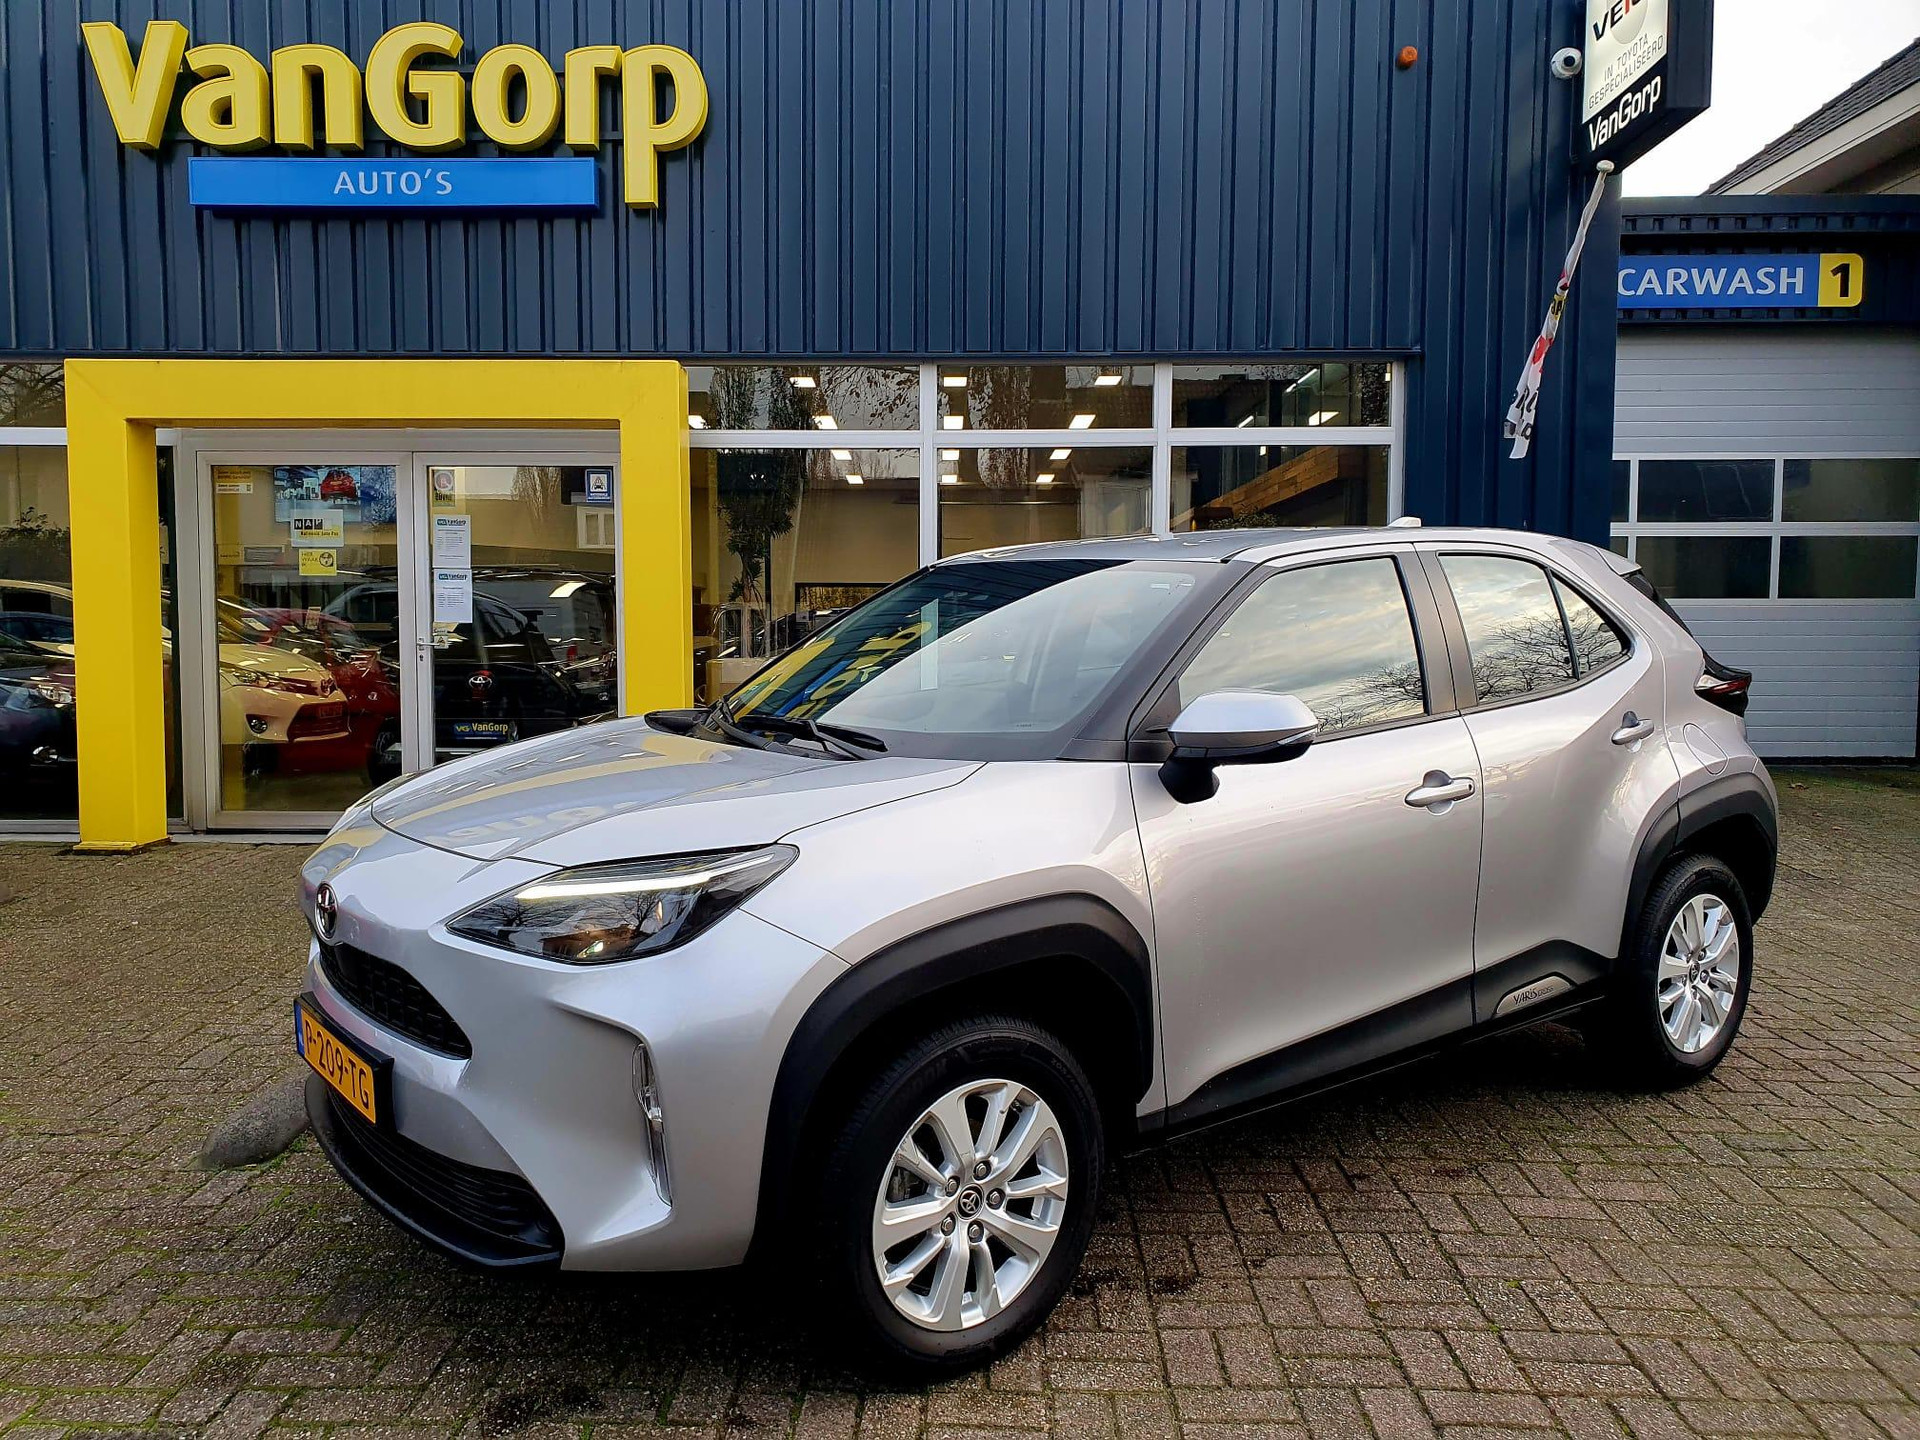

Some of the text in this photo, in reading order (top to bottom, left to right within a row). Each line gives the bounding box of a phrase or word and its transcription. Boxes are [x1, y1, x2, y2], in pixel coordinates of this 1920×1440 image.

[1587, 35, 1664, 109] GESPECIALISEERD
[1604, 33, 1649, 82] IN TOYOTA
[81, 21, 709, 209] VanGorp
[1588, 75, 1661, 151] VanGorp
[333, 170, 453, 196] AUTO'S
[1617, 262, 1851, 298] CARWASH 1
[294, 518, 323, 529] NAP
[471, 722, 508, 735] VanGorp
[304, 1019, 370, 1110] P-209-TG
